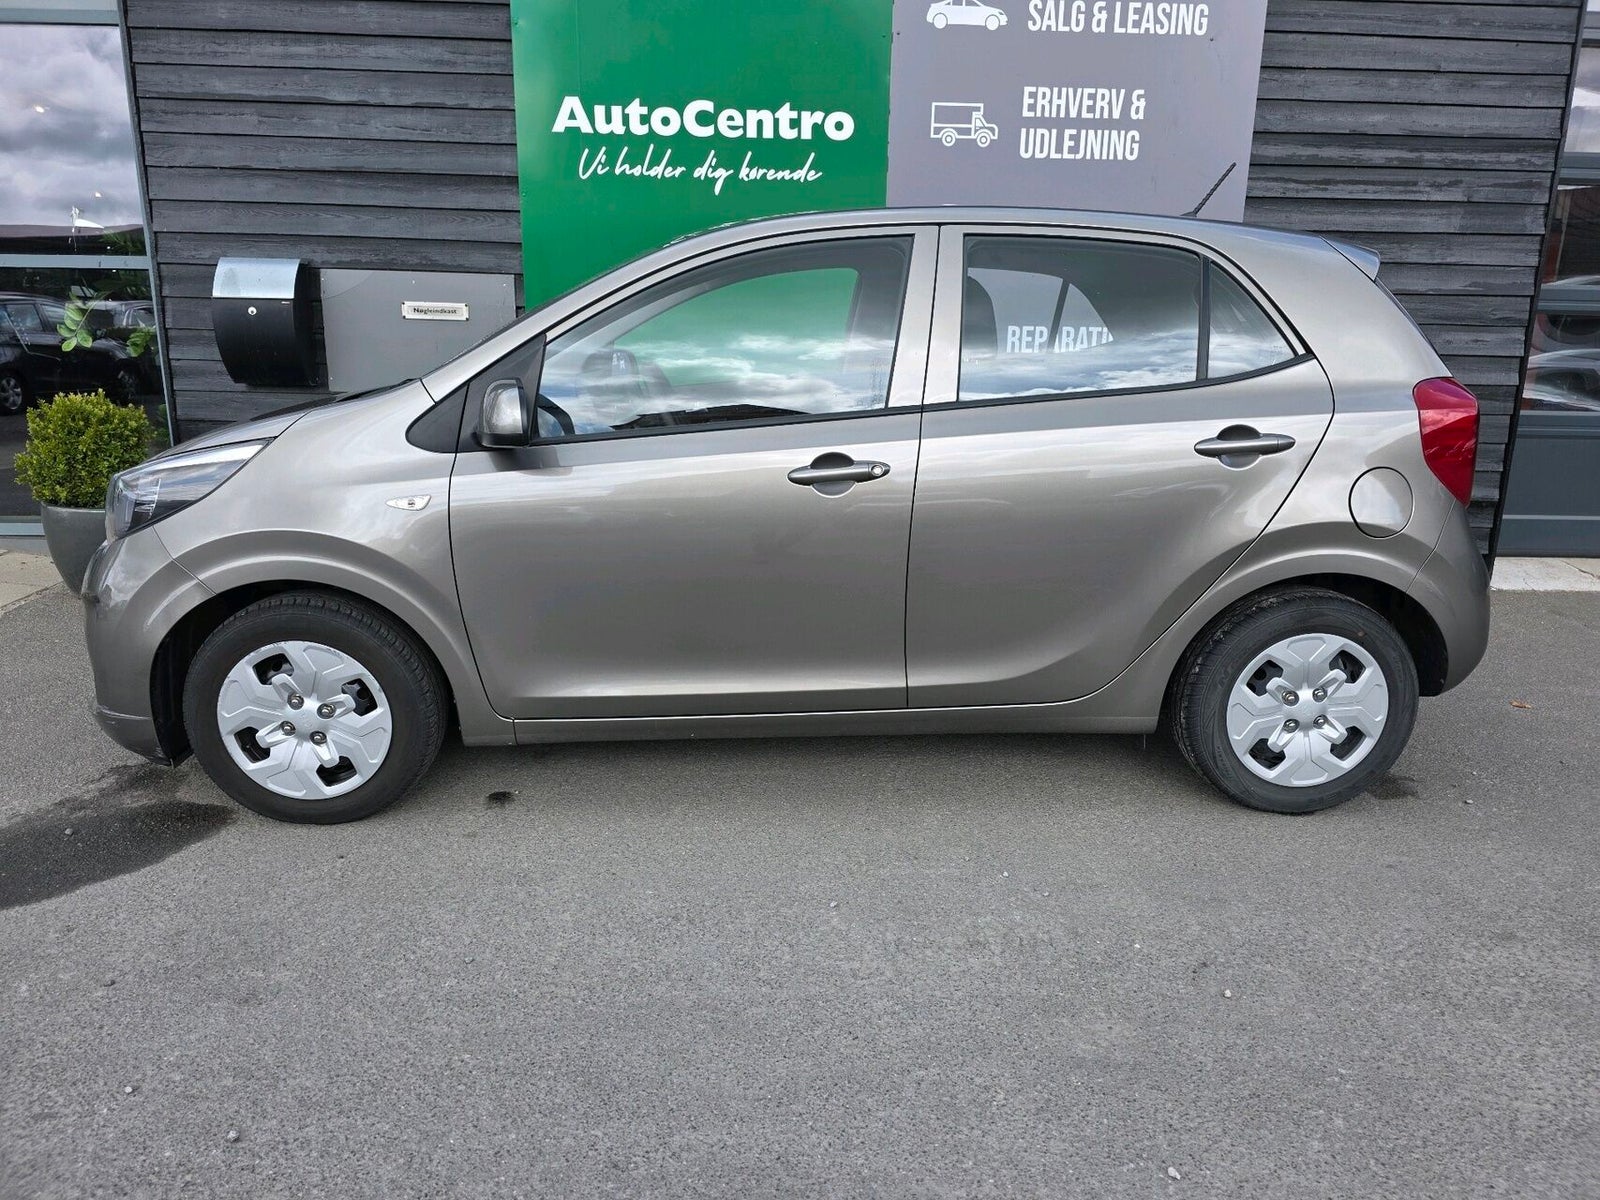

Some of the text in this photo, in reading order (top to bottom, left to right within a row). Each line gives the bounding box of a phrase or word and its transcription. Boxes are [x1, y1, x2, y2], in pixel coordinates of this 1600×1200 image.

[1027, 0, 1209, 36] SALG & LEASING
[551, 96, 855, 141] AutoCentro
[1022, 86, 1147, 120] ERHVERV &
[1019, 127, 1141, 161] UDLEJNING
[578, 146, 610, 180] Vi
[614, 143, 687, 179] holder
[693, 149, 734, 196] dig
